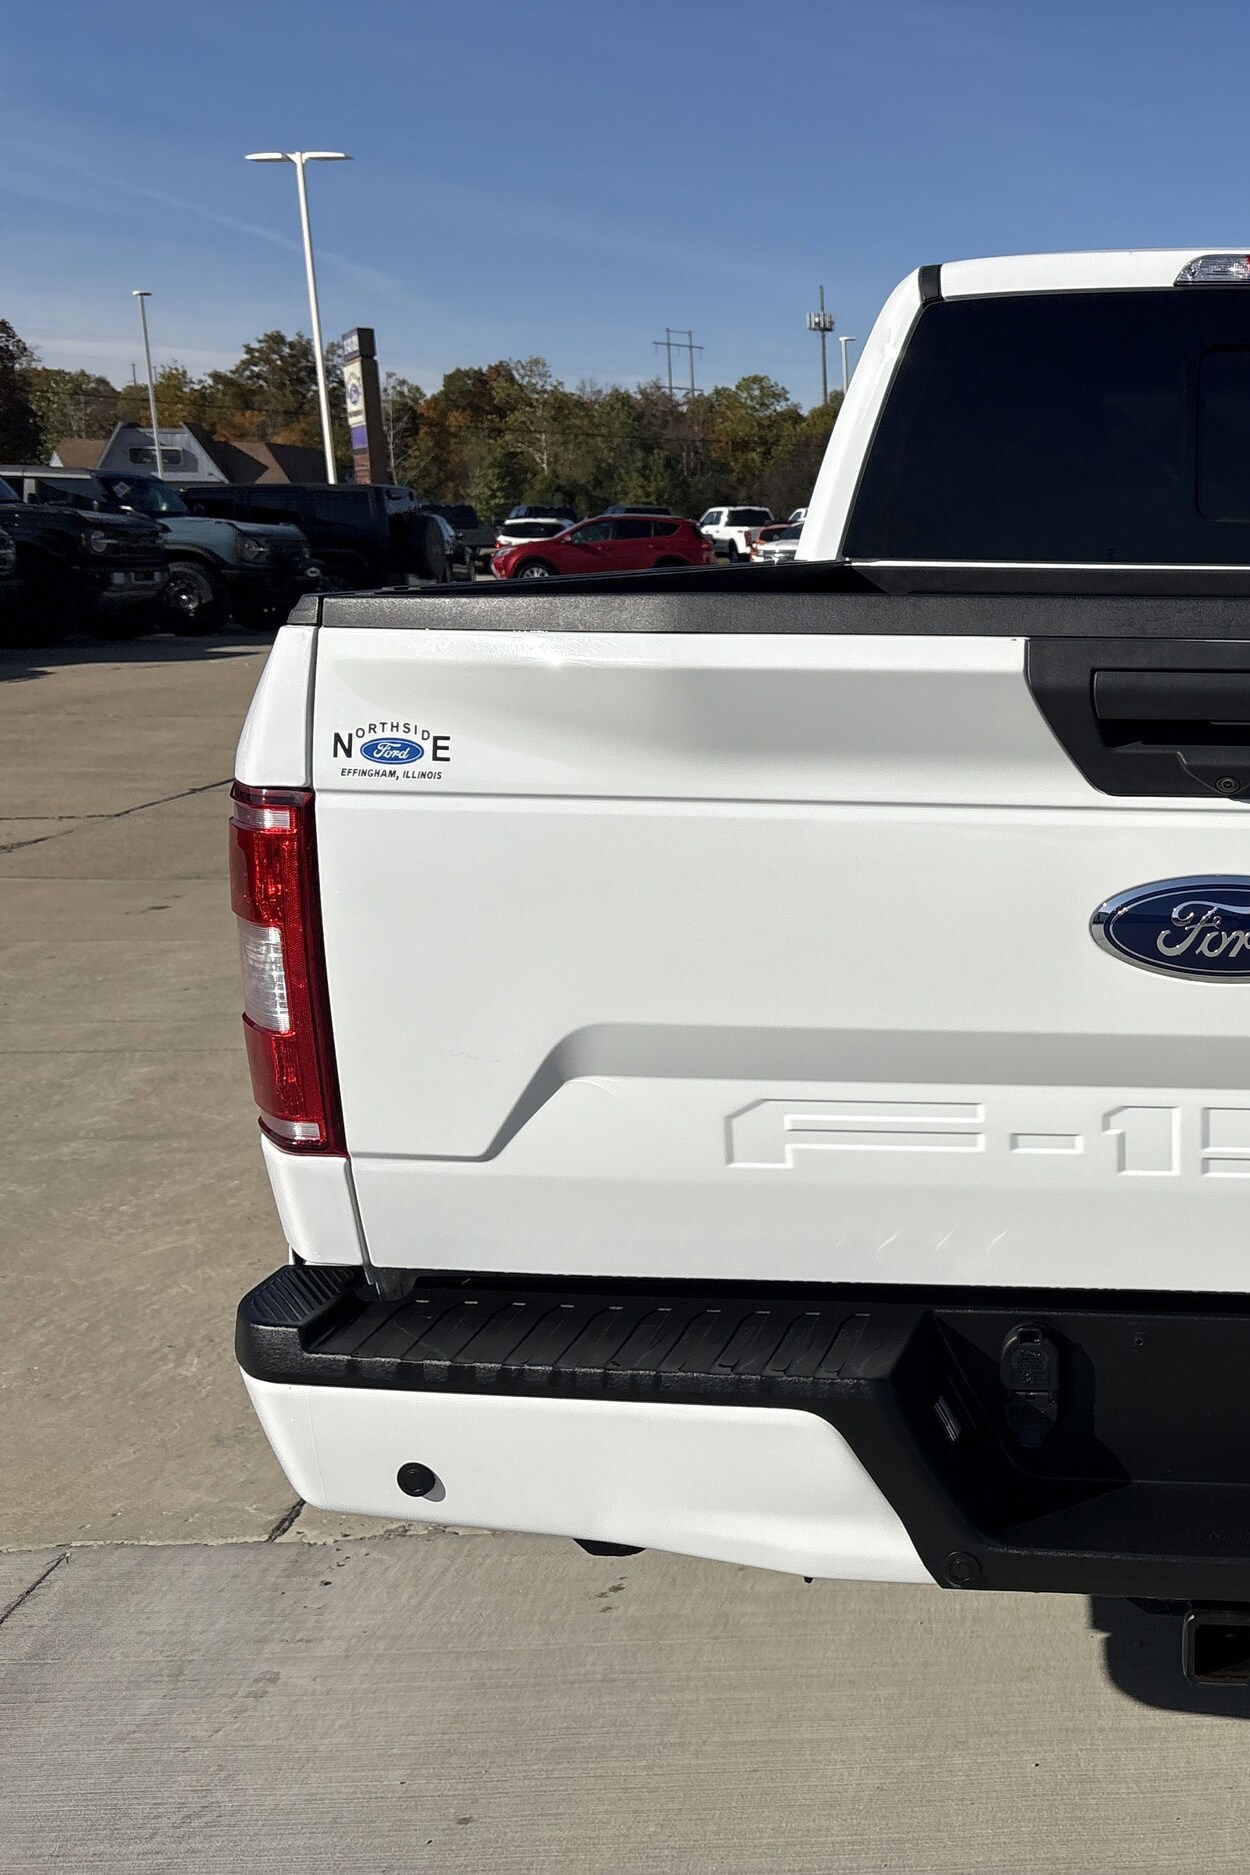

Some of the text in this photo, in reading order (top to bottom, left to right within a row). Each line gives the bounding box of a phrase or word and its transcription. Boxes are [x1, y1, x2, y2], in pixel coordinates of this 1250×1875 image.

[333, 721, 450, 761] NORTHSIDE
[373, 742, 411, 759] Ford
[340, 768, 442, 781] EFFINGHAM, ILLINOIS
